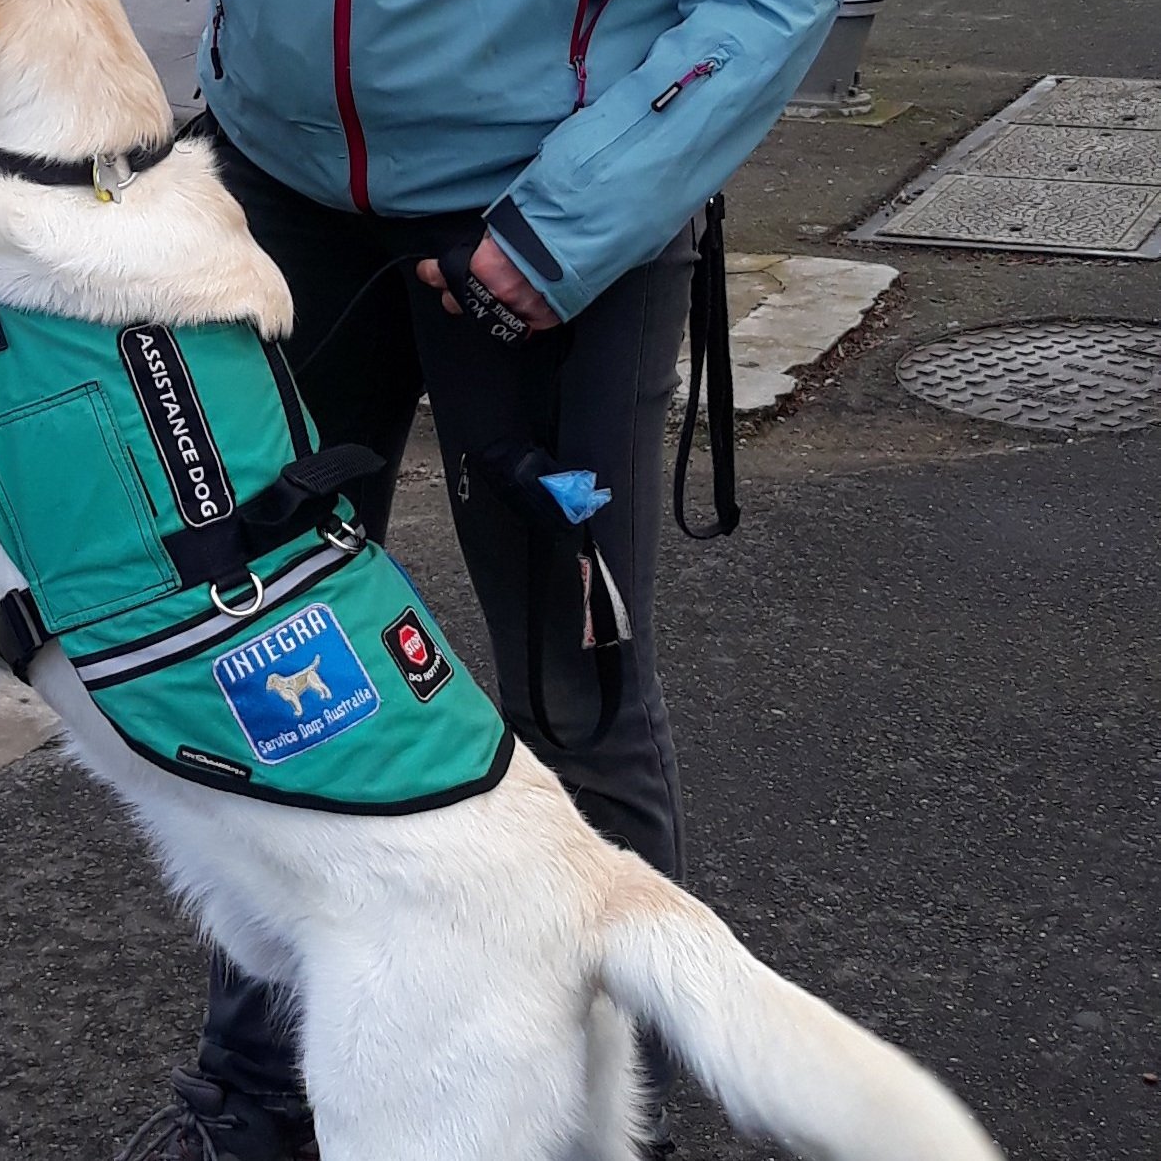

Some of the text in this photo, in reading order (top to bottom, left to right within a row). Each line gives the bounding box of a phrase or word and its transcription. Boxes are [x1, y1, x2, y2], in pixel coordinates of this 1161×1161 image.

[467, 292, 517, 342] DO NO
[135, 332, 218, 518] ASSISTANCE DOG
[222, 609, 328, 684] INTEGRA
[404, 633, 422, 656] STOP
[408, 672, 423, 682] DO
[257, 687, 373, 754] Service Dogs Australia
